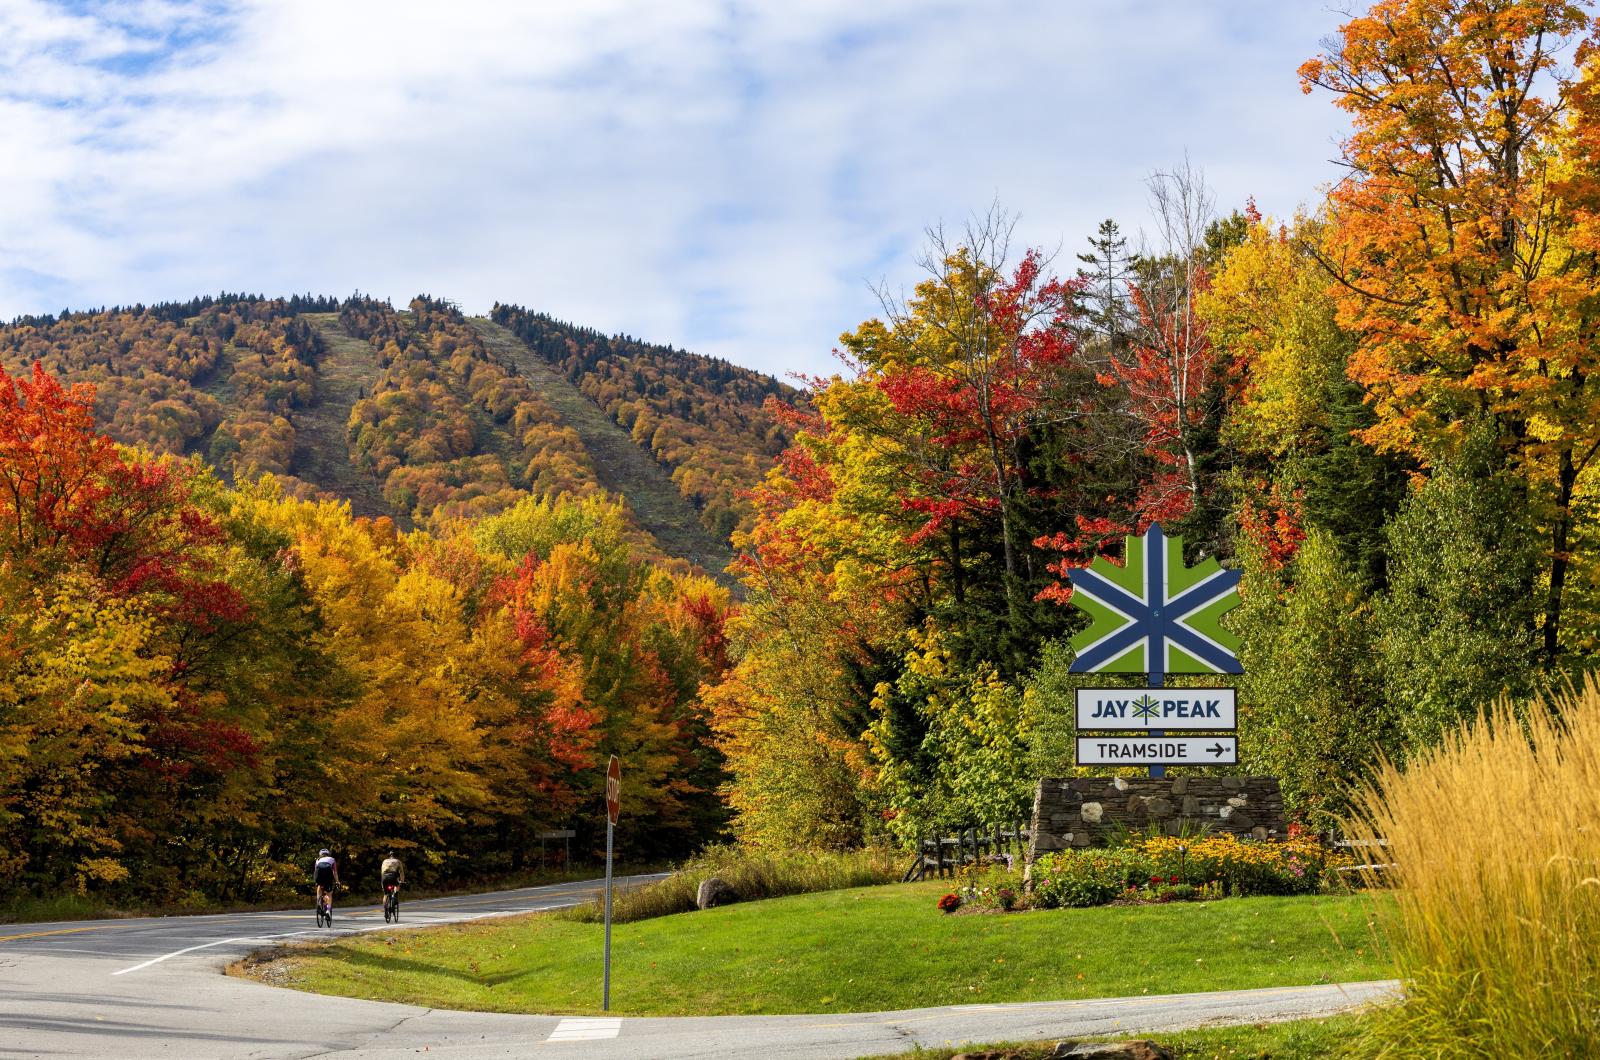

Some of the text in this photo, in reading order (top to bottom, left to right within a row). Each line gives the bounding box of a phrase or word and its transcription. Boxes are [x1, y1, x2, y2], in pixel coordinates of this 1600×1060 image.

[1091, 700, 1220, 718] JAY PEAK
[1097, 743, 1187, 758] TRAMSIDE
[608, 776, 620, 803] STOP
